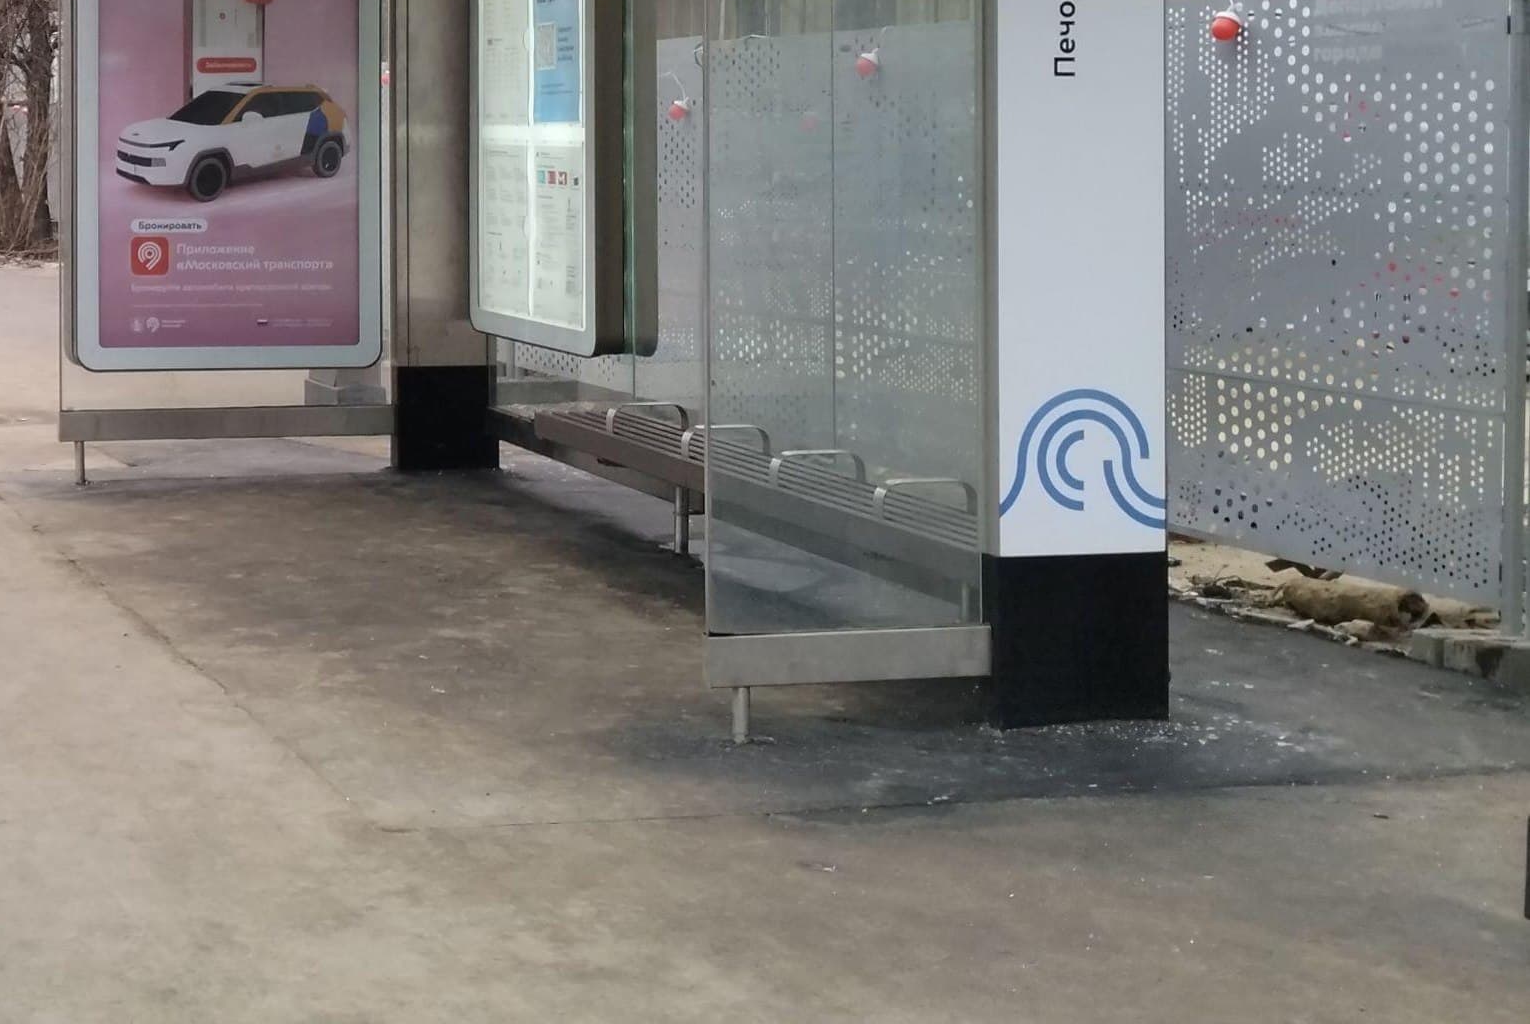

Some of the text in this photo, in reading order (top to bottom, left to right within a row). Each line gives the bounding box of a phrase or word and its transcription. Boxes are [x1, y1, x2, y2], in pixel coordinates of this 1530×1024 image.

[138, 220, 202, 231] Бронировать
[176, 242, 255, 256] Приложение
[176, 259, 334, 271] «Московский транспорт»
